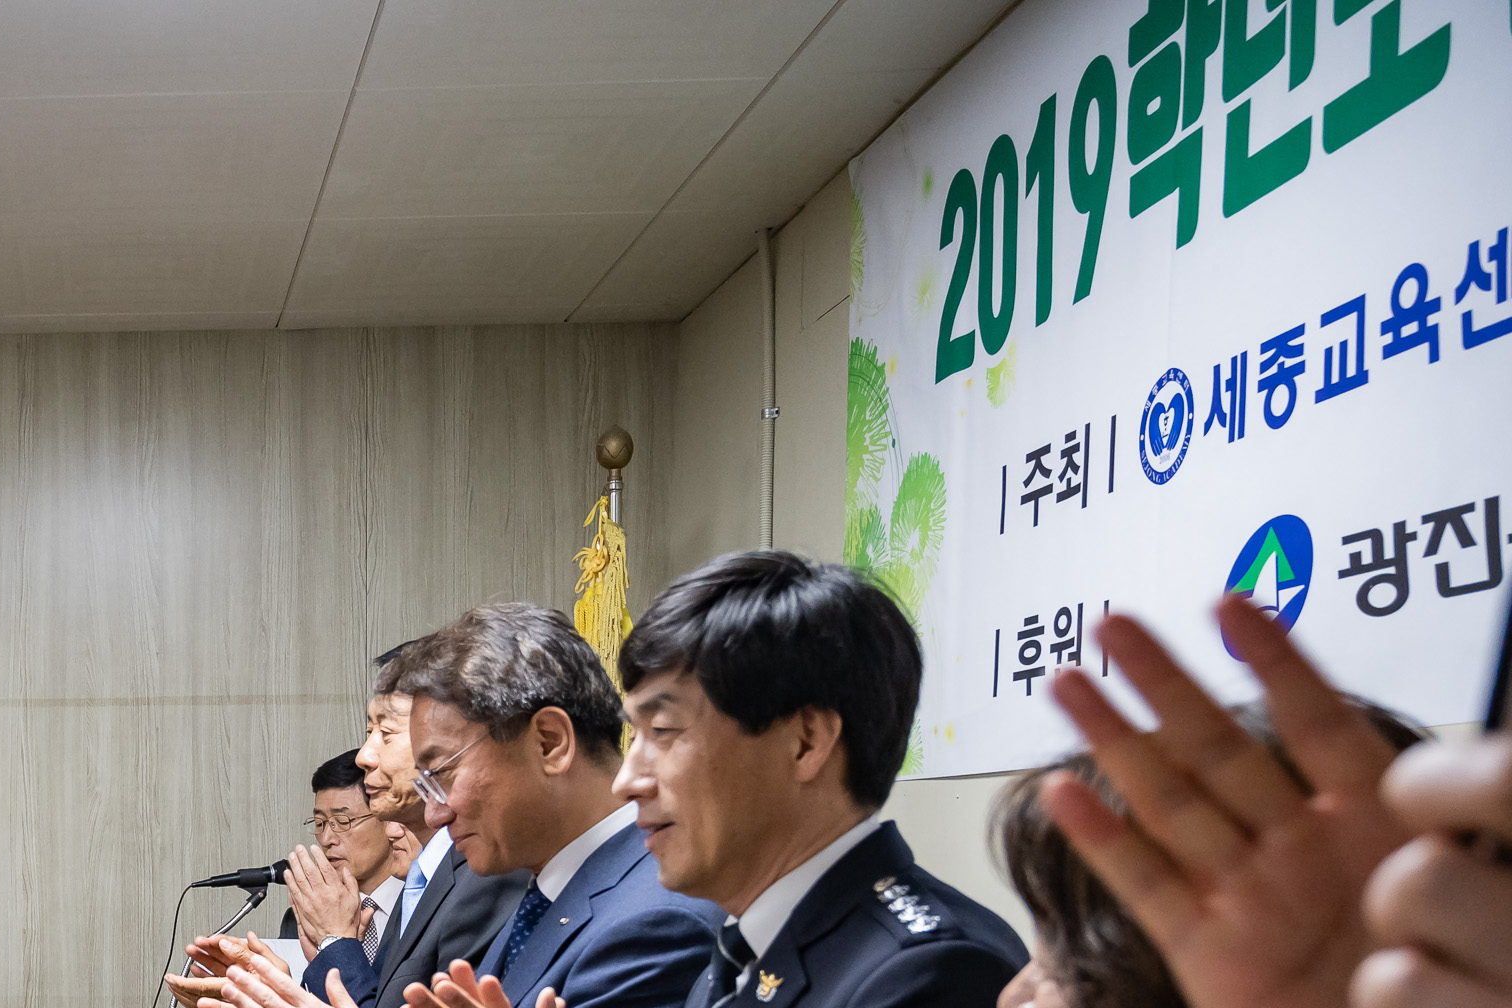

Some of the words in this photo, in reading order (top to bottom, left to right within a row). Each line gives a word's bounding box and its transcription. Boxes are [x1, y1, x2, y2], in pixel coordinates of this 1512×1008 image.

[1020, 422, 1091, 528] 주최
[1203, 226, 1512, 444] 세종교육센
[1012, 602, 1084, 697] 후원
[1337, 494, 1512, 618] 광진
